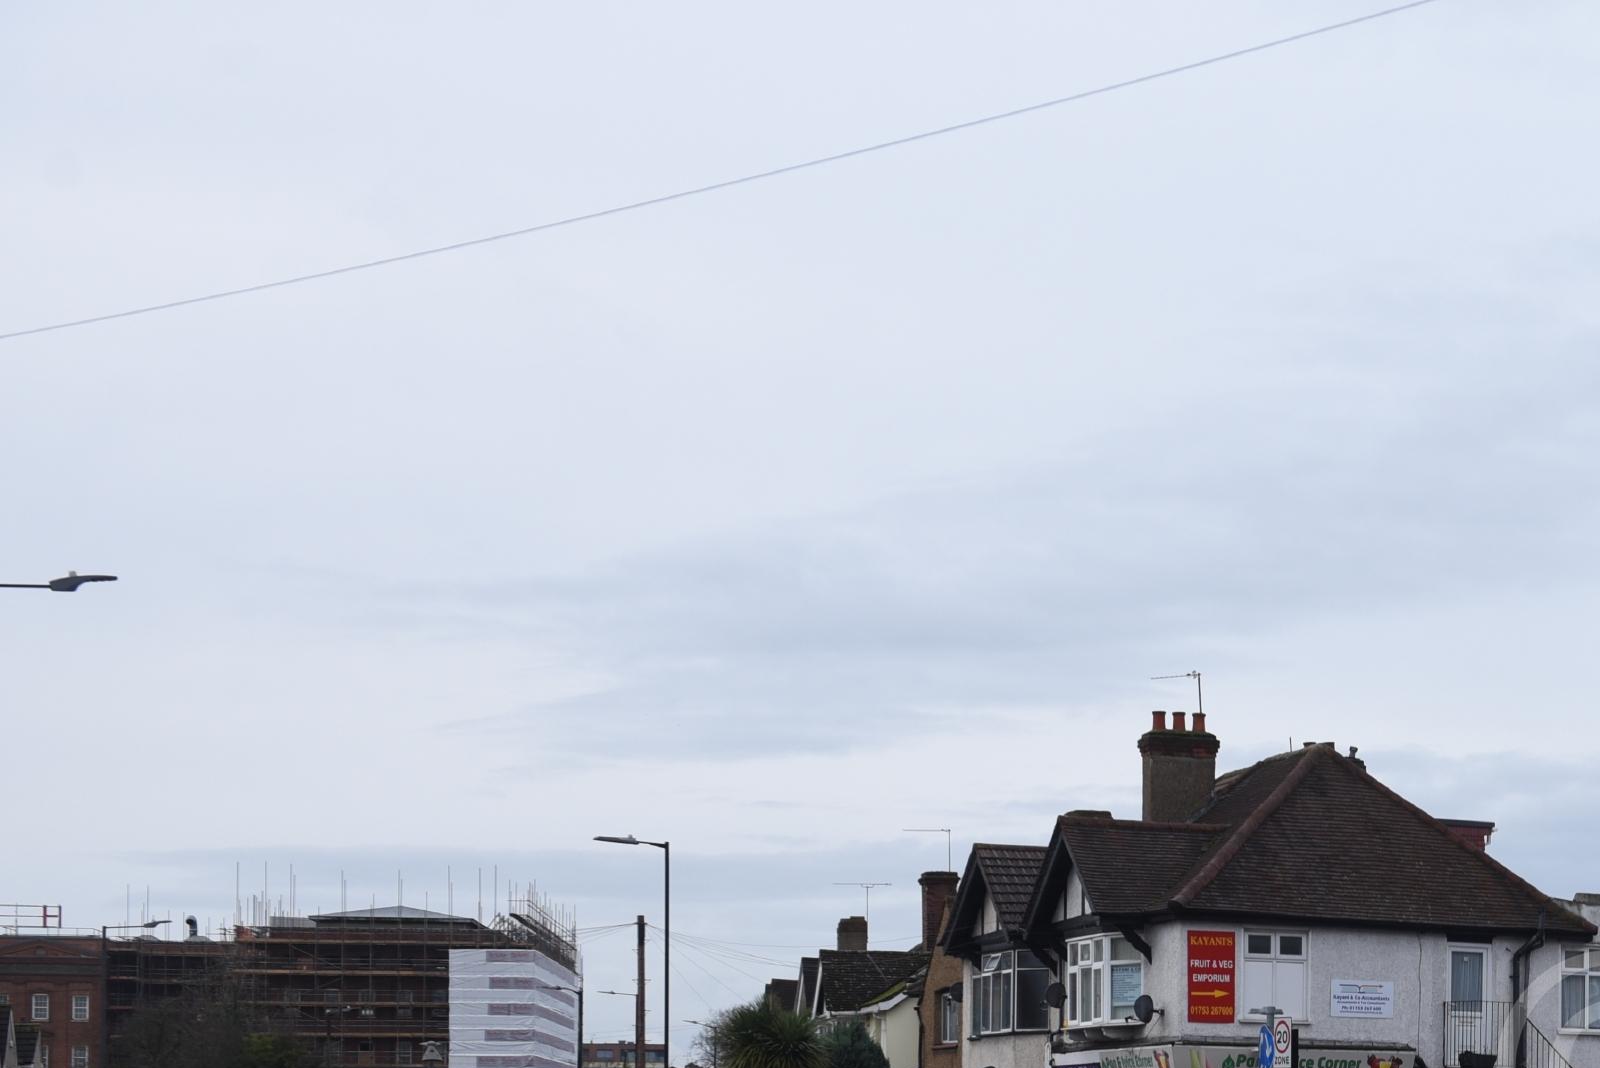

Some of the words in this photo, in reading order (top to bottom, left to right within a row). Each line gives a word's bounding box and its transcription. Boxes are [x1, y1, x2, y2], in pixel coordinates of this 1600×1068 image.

[1190, 935, 1233, 946] KAYANI'S
[1190, 959, 1211, 968] FRUIT
[1212, 960, 1218, 968] &
[1219, 960, 1234, 969] VEG
[1192, 973, 1231, 982] EMPORIUM
[1190, 1005, 1210, 1015] 01753
[1276, 1030, 1288, 1044] 20
[1274, 1056, 1290, 1065] ZONE
